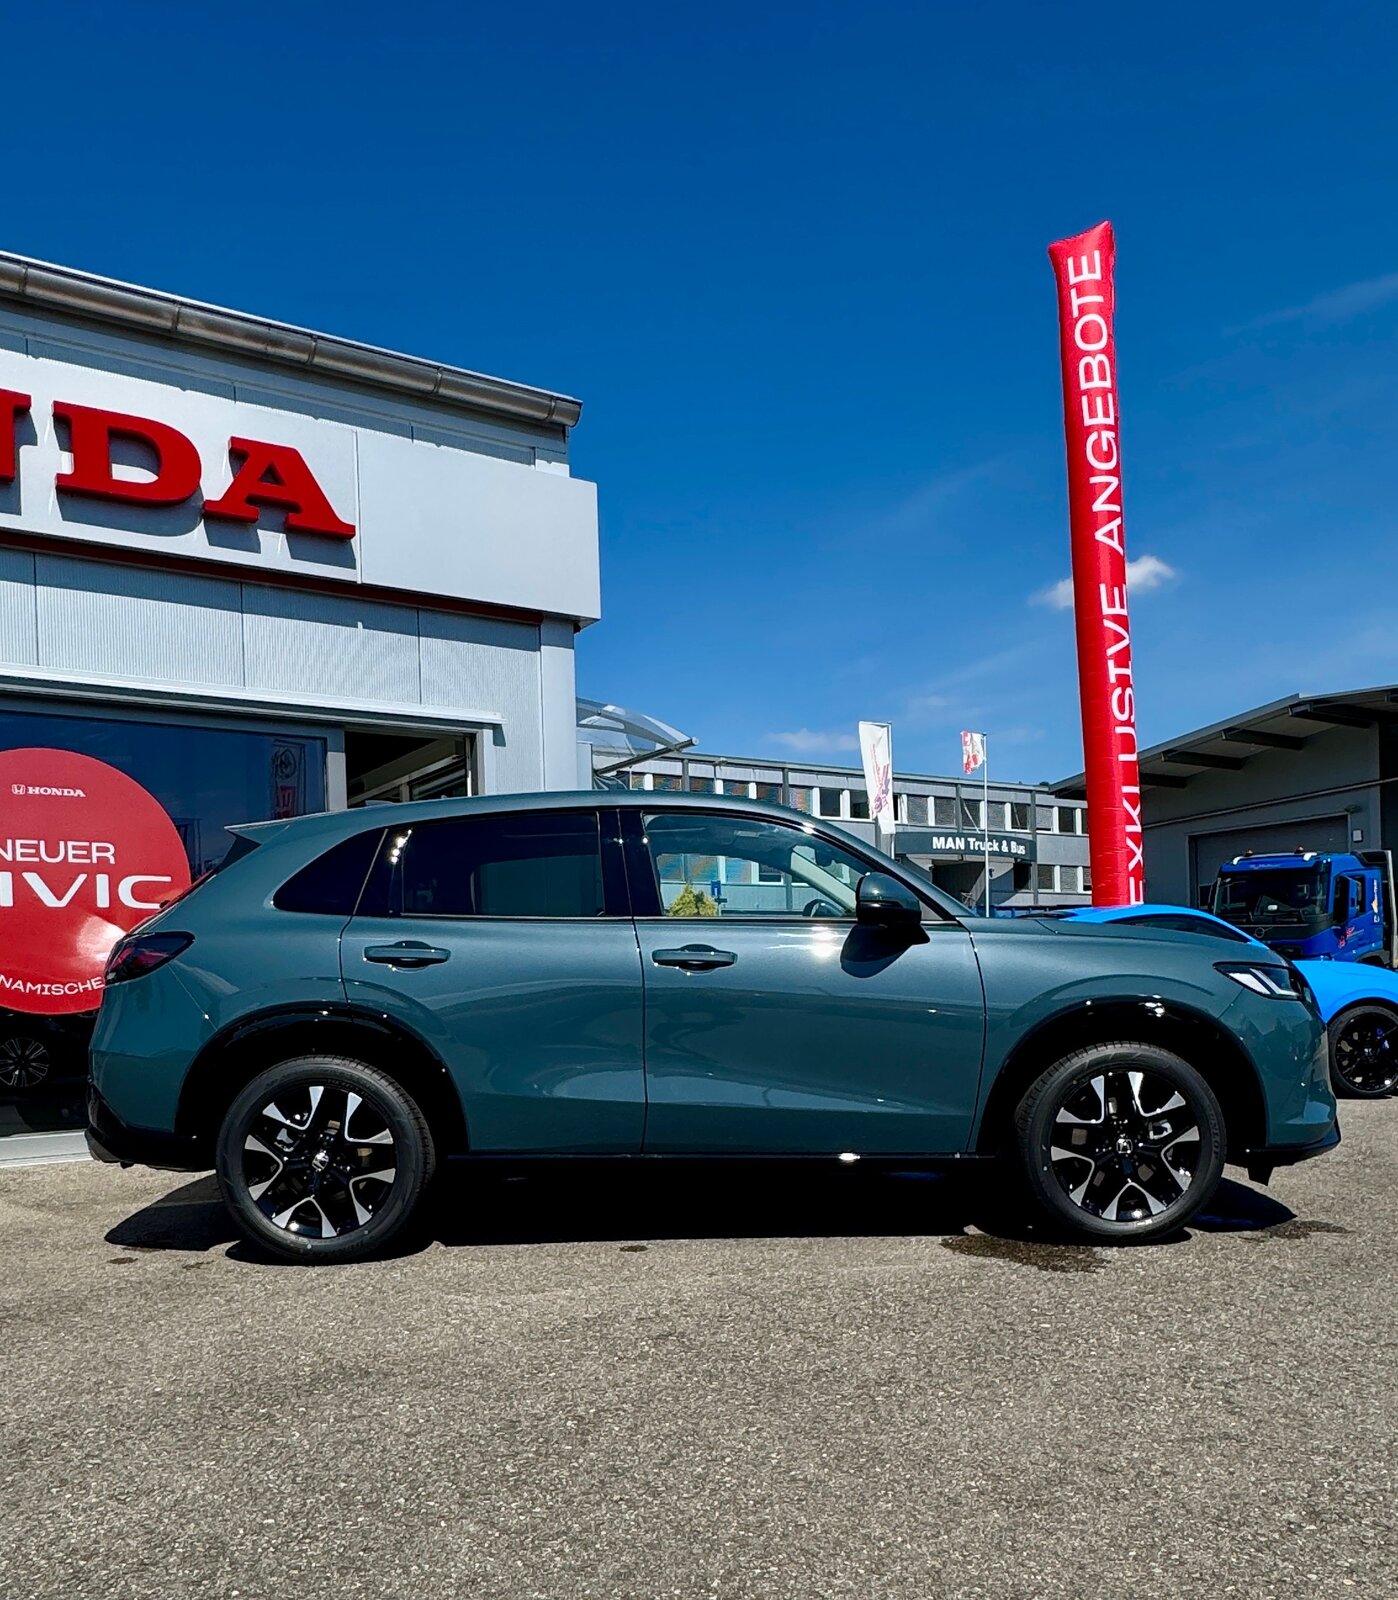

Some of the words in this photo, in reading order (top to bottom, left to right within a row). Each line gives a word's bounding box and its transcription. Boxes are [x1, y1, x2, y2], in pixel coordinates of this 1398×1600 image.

[1067, 249, 1124, 557] ANGEBOTE
[0, 388, 356, 540] DA
[27, 786, 87, 798] HONDA
[932, 836, 965, 850] MAN
[967, 837, 999, 852] Truck
[1001, 840, 1009, 853] &
[1010, 841, 1026, 855] Bus
